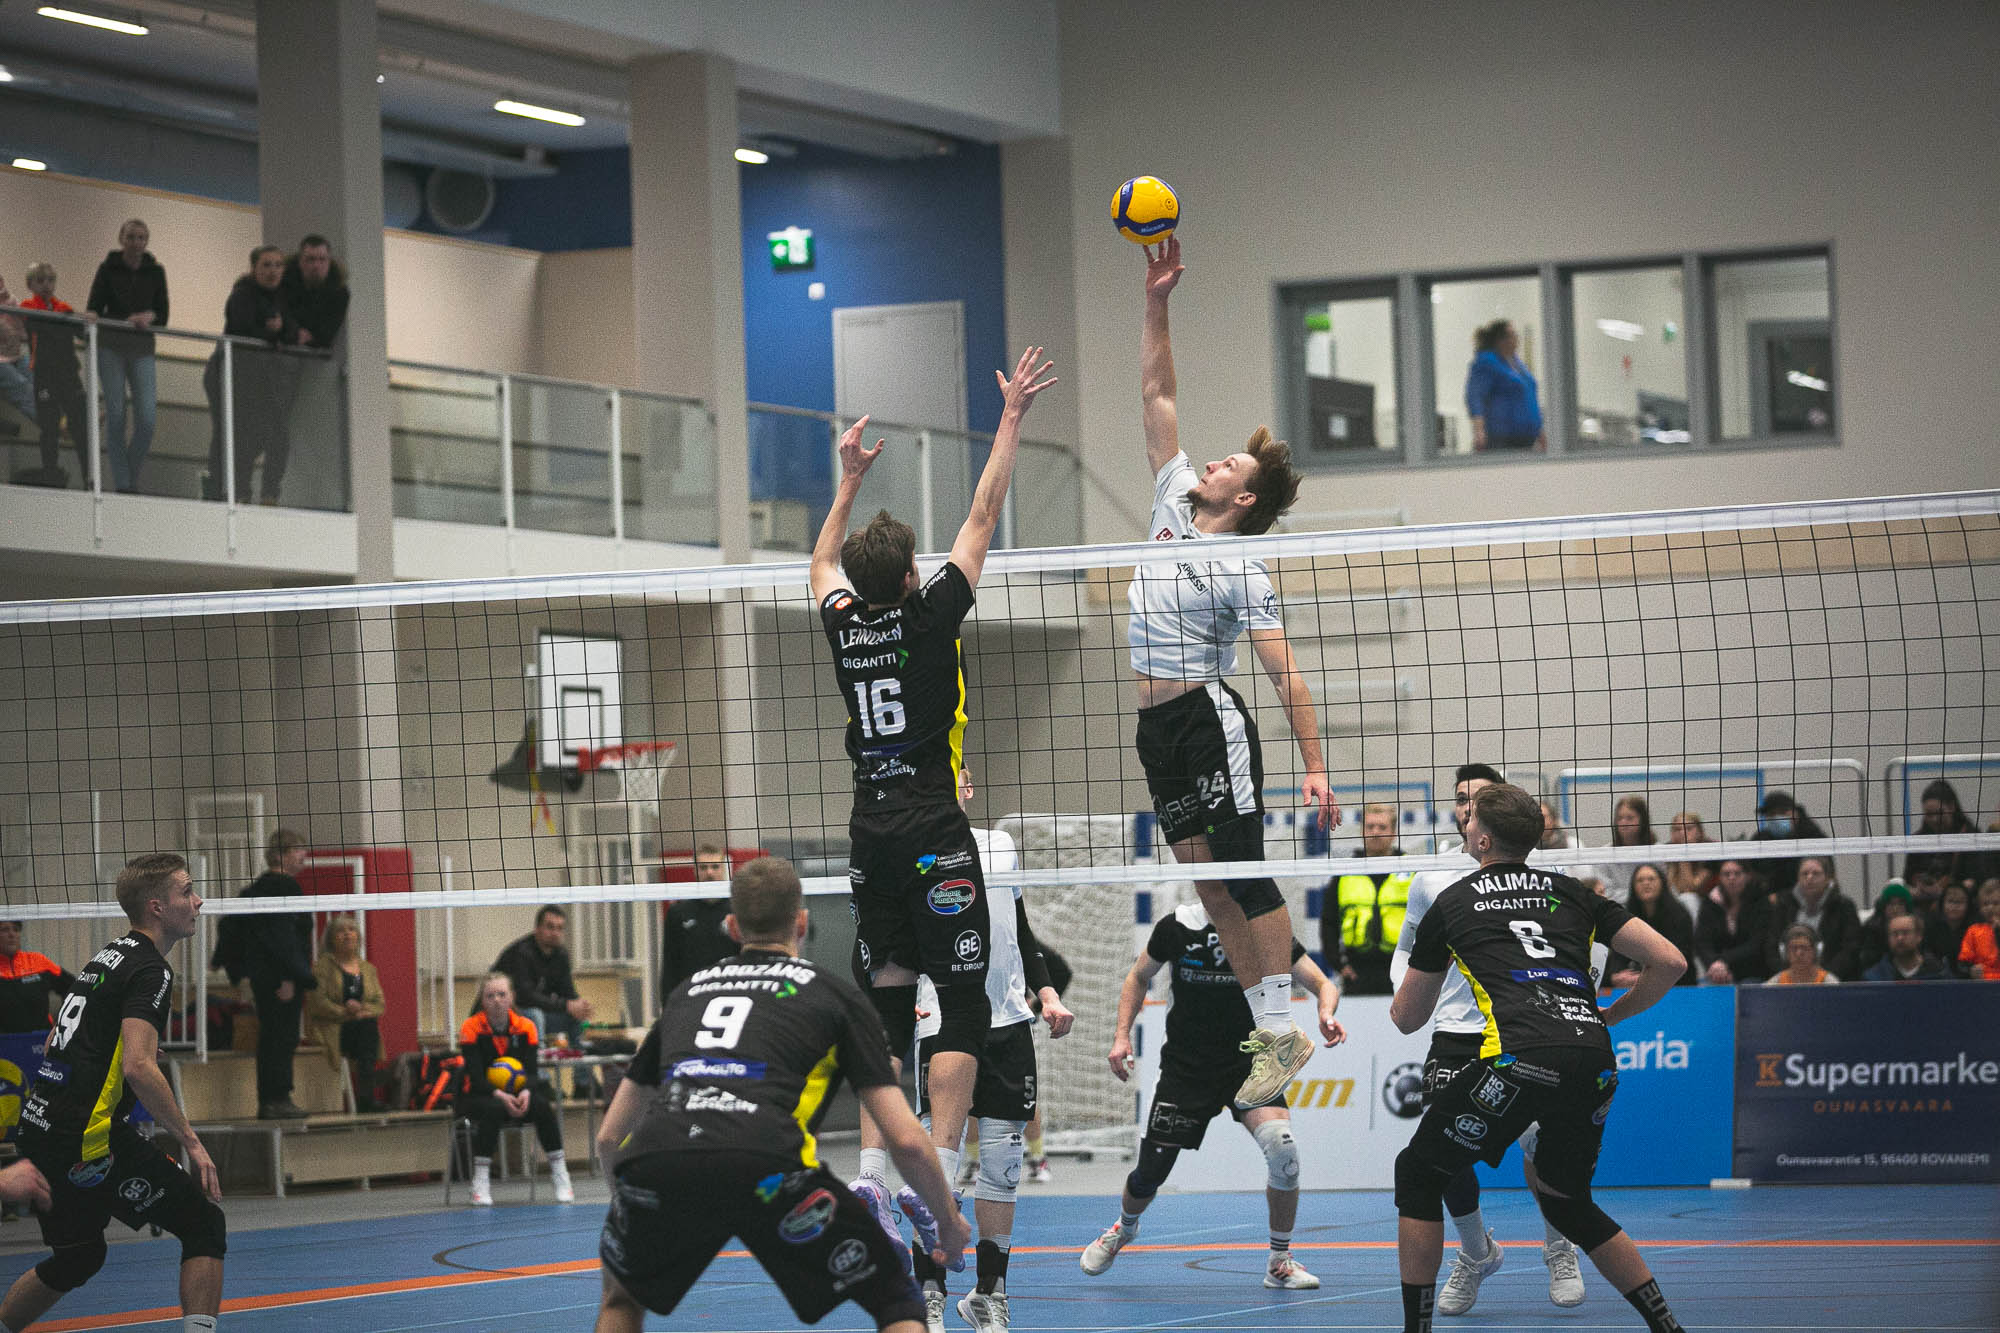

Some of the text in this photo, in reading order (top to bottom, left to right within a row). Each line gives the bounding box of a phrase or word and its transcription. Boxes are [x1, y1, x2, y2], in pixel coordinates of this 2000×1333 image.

[1181, 563, 1206, 592] XPRESS
[842, 652, 896, 669] GIGANTTI
[854, 678, 906, 738] 16
[1470, 873, 1552, 894] VÄLIMAA
[1474, 898, 1546, 911] GIGANTTI
[960, 936, 978, 956] BE
[694, 996, 753, 1049] 9
[36, 1106, 45, 1117] &
[1813, 1100, 1953, 1113] OUNASVAARA
[1458, 1117, 1484, 1135] BE
